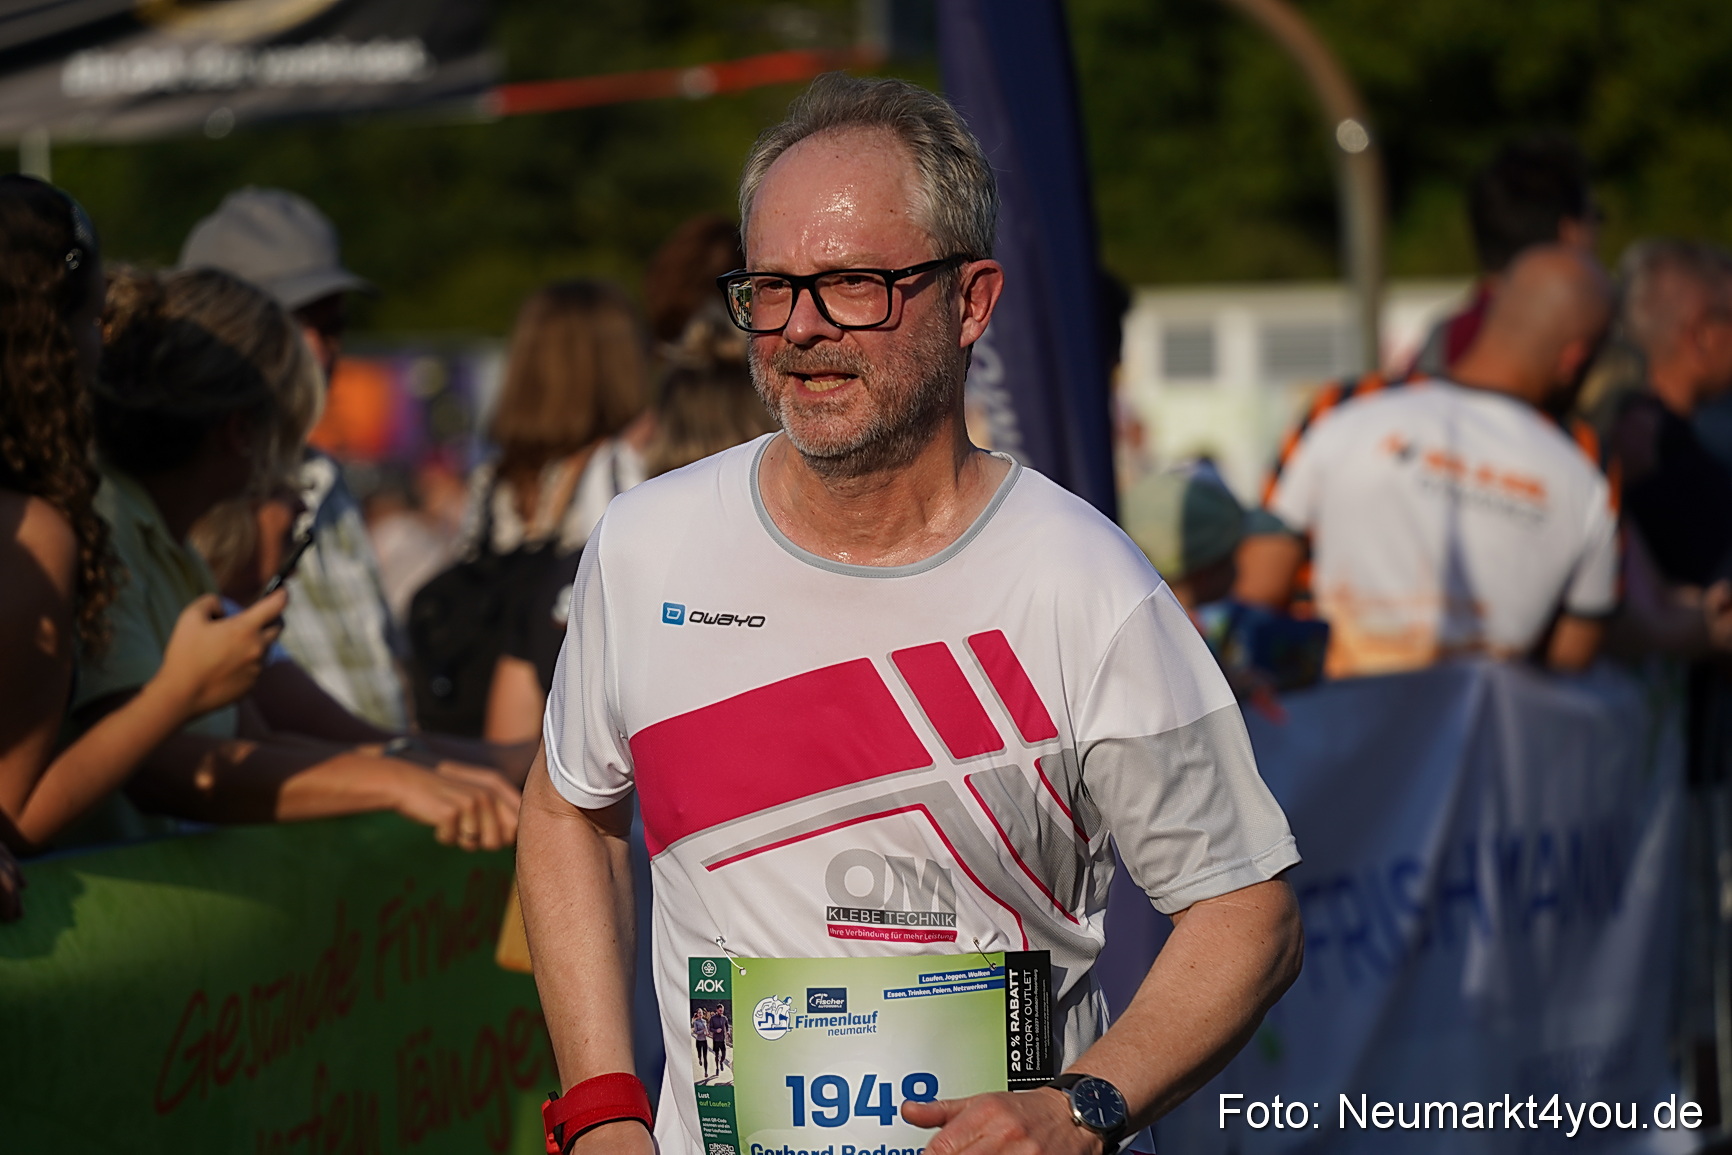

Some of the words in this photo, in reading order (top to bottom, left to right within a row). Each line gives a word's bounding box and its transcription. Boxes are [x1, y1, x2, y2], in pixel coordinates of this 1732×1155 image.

[825, 849, 956, 912] OM
[828, 907, 881, 923] KLEBE
[885, 911, 955, 927] TECHNIK
[829, 927, 844, 936] Ihre
[845, 928, 889, 940] Verbindung
[890, 931, 902, 940] für
[903, 932, 923, 940] mehr
[924, 933, 954, 941] Leistung
[694, 979, 726, 993] AOK
[922, 974, 945, 983] Laufen,
[945, 972, 968, 981] Joggen,
[968, 970, 991, 979] Walken
[814, 994, 845, 1006] Fischer
[887, 990, 907, 999] Essen,
[907, 988, 931, 997] Trinken,
[932, 986, 953, 995] Feiern,
[952, 983, 988, 993] Netzwerken
[1008, 968, 1020, 1032] RABATT
[1023, 969, 1033, 1016] OUTLET
[795, 1010, 879, 1029] Firmenlauf
[828, 1024, 877, 1037] neumarkt
[1009, 1035, 1021, 1047] %
[1024, 1017, 1034, 1070] FACTORY
[1010, 1050, 1021, 1072] 20
[785, 1072, 939, 1128] 1948
